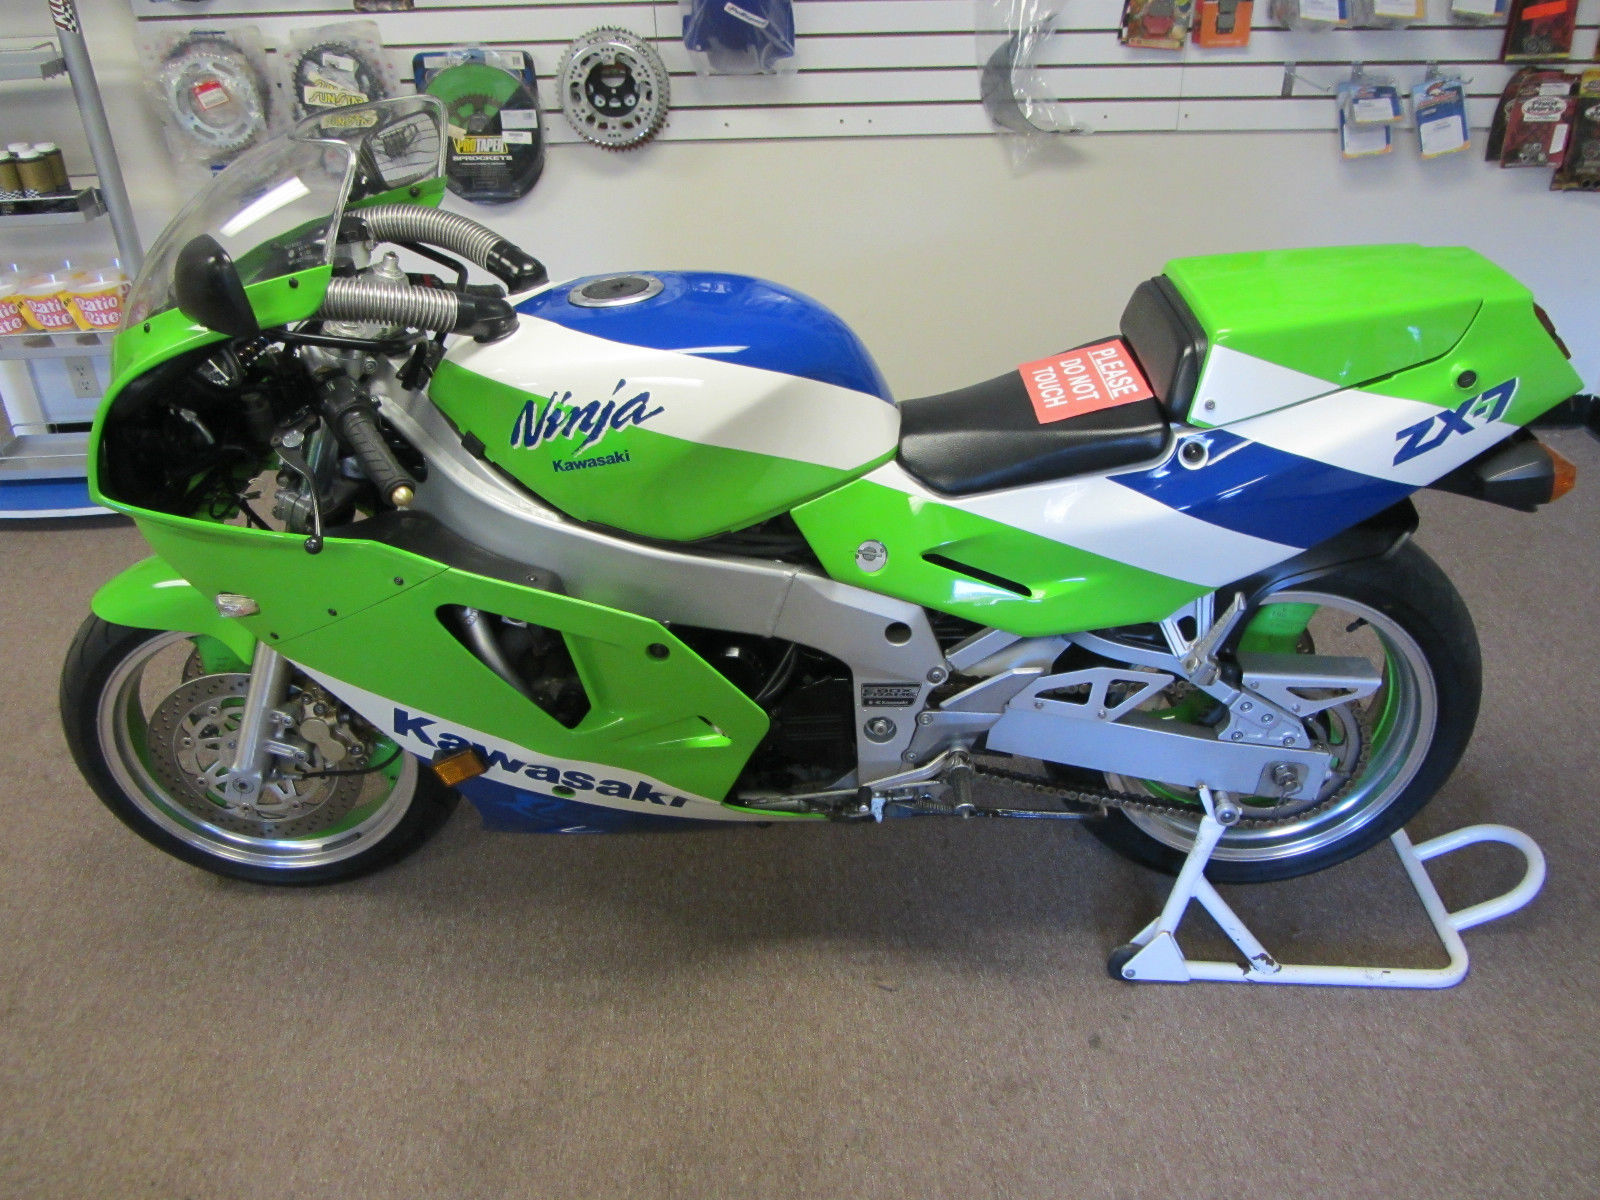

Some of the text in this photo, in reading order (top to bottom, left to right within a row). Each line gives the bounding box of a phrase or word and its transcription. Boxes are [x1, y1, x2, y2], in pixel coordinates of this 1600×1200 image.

[1032, 366, 1068, 408] TOUCH
[1060, 358, 1100, 401] DO NOT
[1092, 347, 1139, 398] PLEASE
[510, 378, 666, 457] Ninja
[1392, 377, 1520, 467] ZX-7
[552, 450, 632, 473] Kawasaki
[393, 707, 690, 808] Kawasaki
